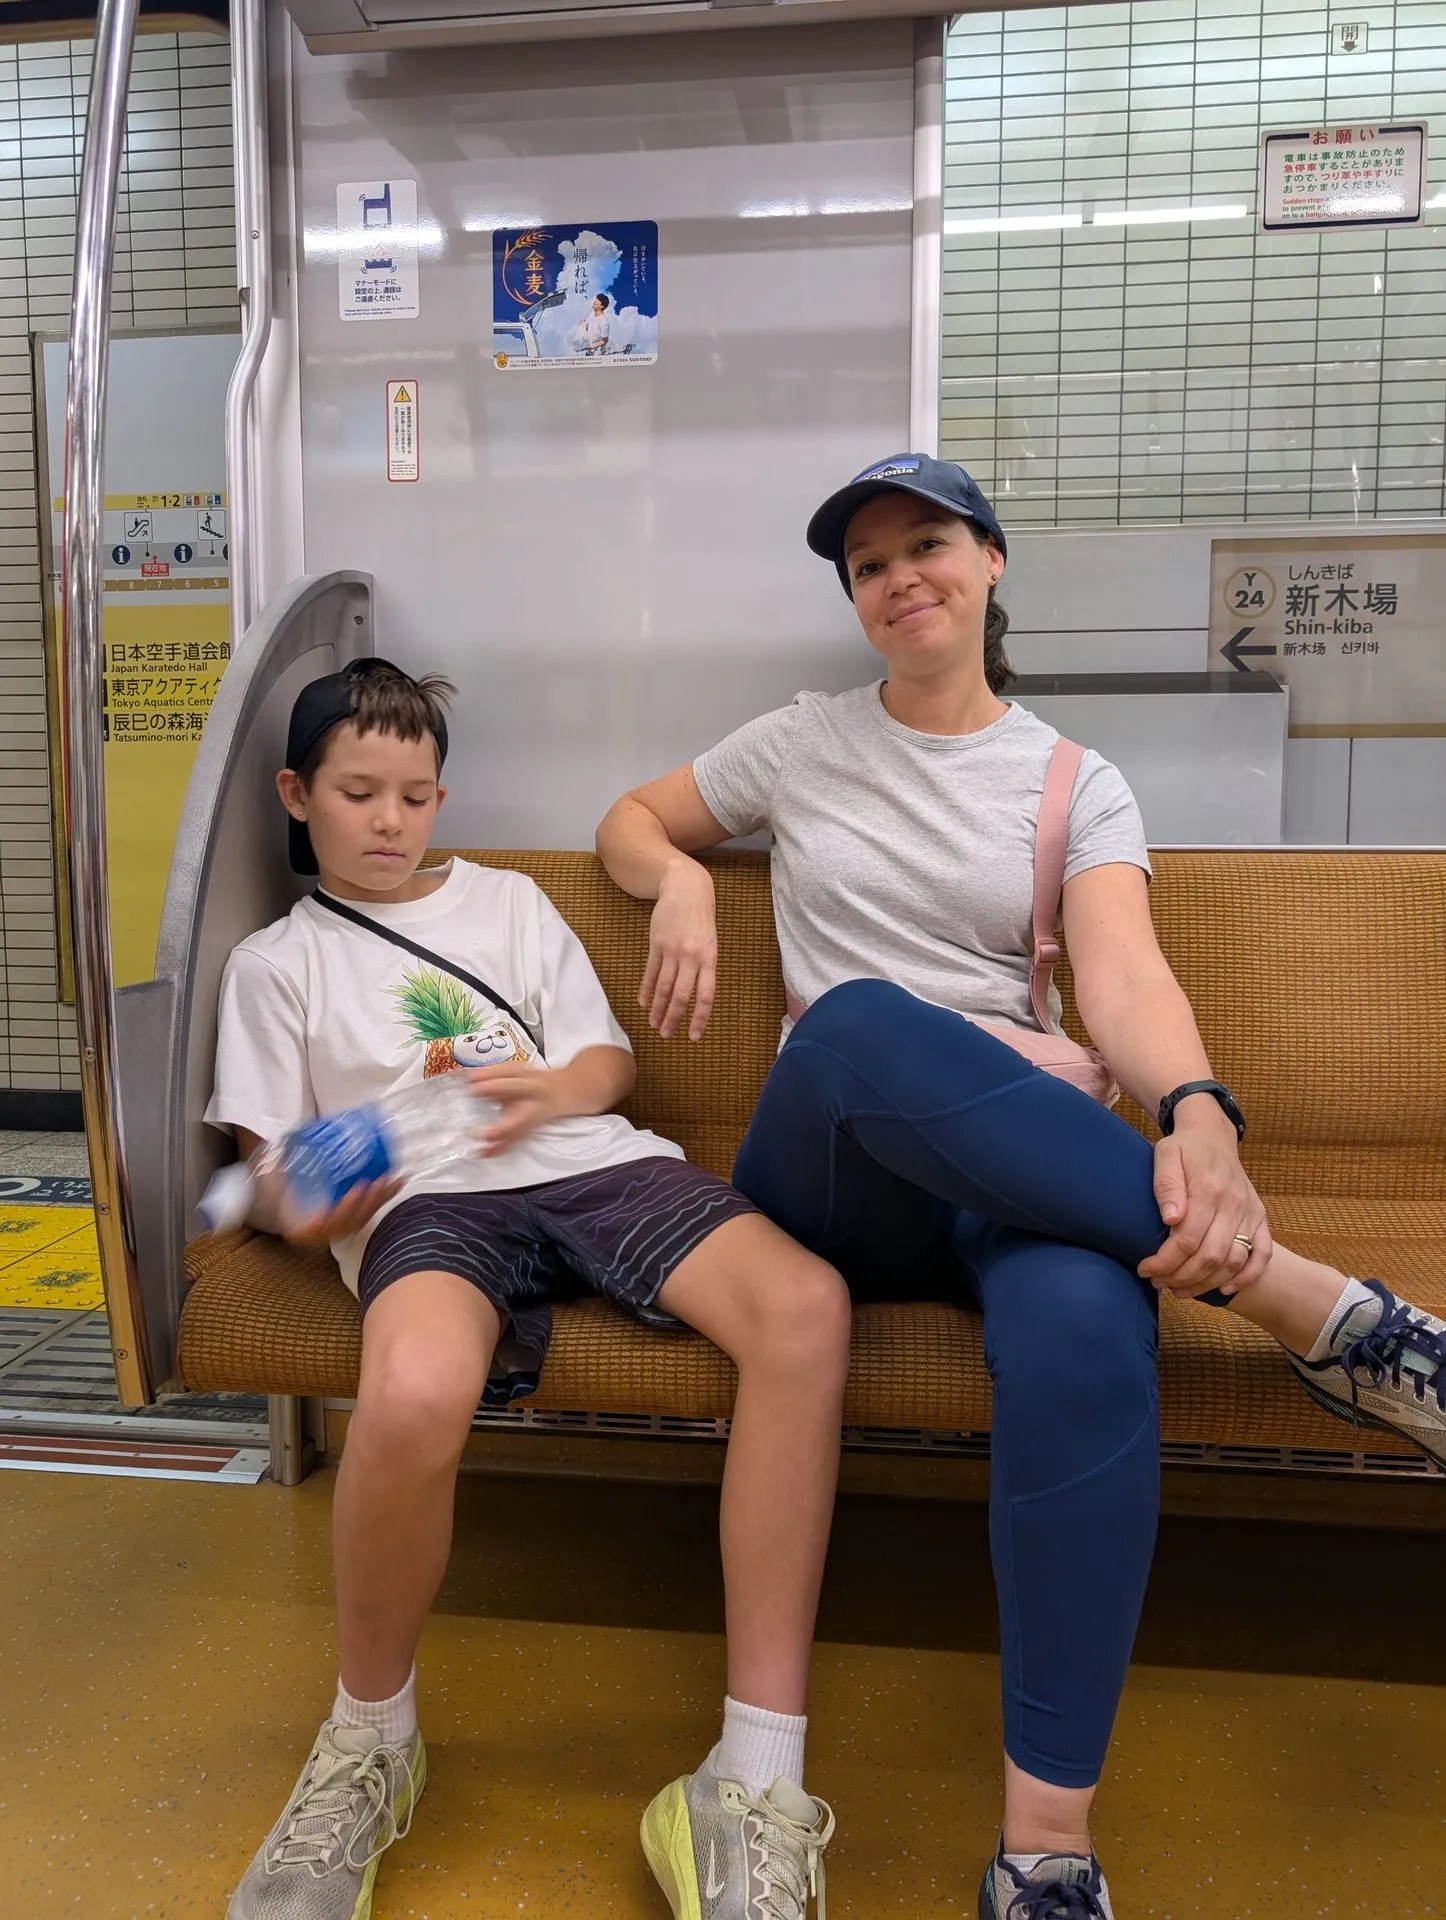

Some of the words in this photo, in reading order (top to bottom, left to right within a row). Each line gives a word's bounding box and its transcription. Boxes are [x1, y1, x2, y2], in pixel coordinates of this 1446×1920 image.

[1341, 25, 1358, 41] 開
[1313, 128, 1374, 145] お願い
[1284, 147, 1405, 163] 電車は事故防止のため
[1284, 158, 1404, 173] 急停車することがありま
[1284, 168, 1404, 183] すので、つり革や手すりに
[1282, 197, 1307, 205] Sudden
[1291, 204, 1316, 213] prevent
[524, 249, 544, 296] 金麦
[573, 248, 588, 299] 帰れば、
[355, 279, 397, 287] マナーモードに
[355, 286, 402, 295] 設定の上、通話は
[355, 295, 401, 303] ご遠慮ください。
[868, 467, 914, 480] agonia
[143, 564, 167, 573] 現在地
[1288, 563, 1355, 581] しんきば
[129, 581, 135, 590] 8
[157, 580, 162, 588] 7
[185, 579, 191, 588] 6
[214, 579, 219, 588] 5
[1244, 572, 1257, 587] Y
[1235, 590, 1265, 608] 24
[1285, 583, 1399, 617] 新木場
[1284, 618, 1373, 635] Shin-kiba
[1283, 642, 1326, 656] 新木场
[1341, 641, 1380, 655] 신키바
[111, 664, 139, 675] Japan
[141, 663, 186, 673] Karatedo
[189, 662, 208, 672] Hall
[112, 676, 221, 697] 東京アクアティク
[112, 699, 140, 709] Tokyo
[143, 698, 185, 708] Aquatics
[188, 697, 214, 706] Centr
[113, 712, 209, 731] 辰巳の森海
[114, 732, 188, 742] Tatsumino-mori
[192, 732, 203, 741] Ka
